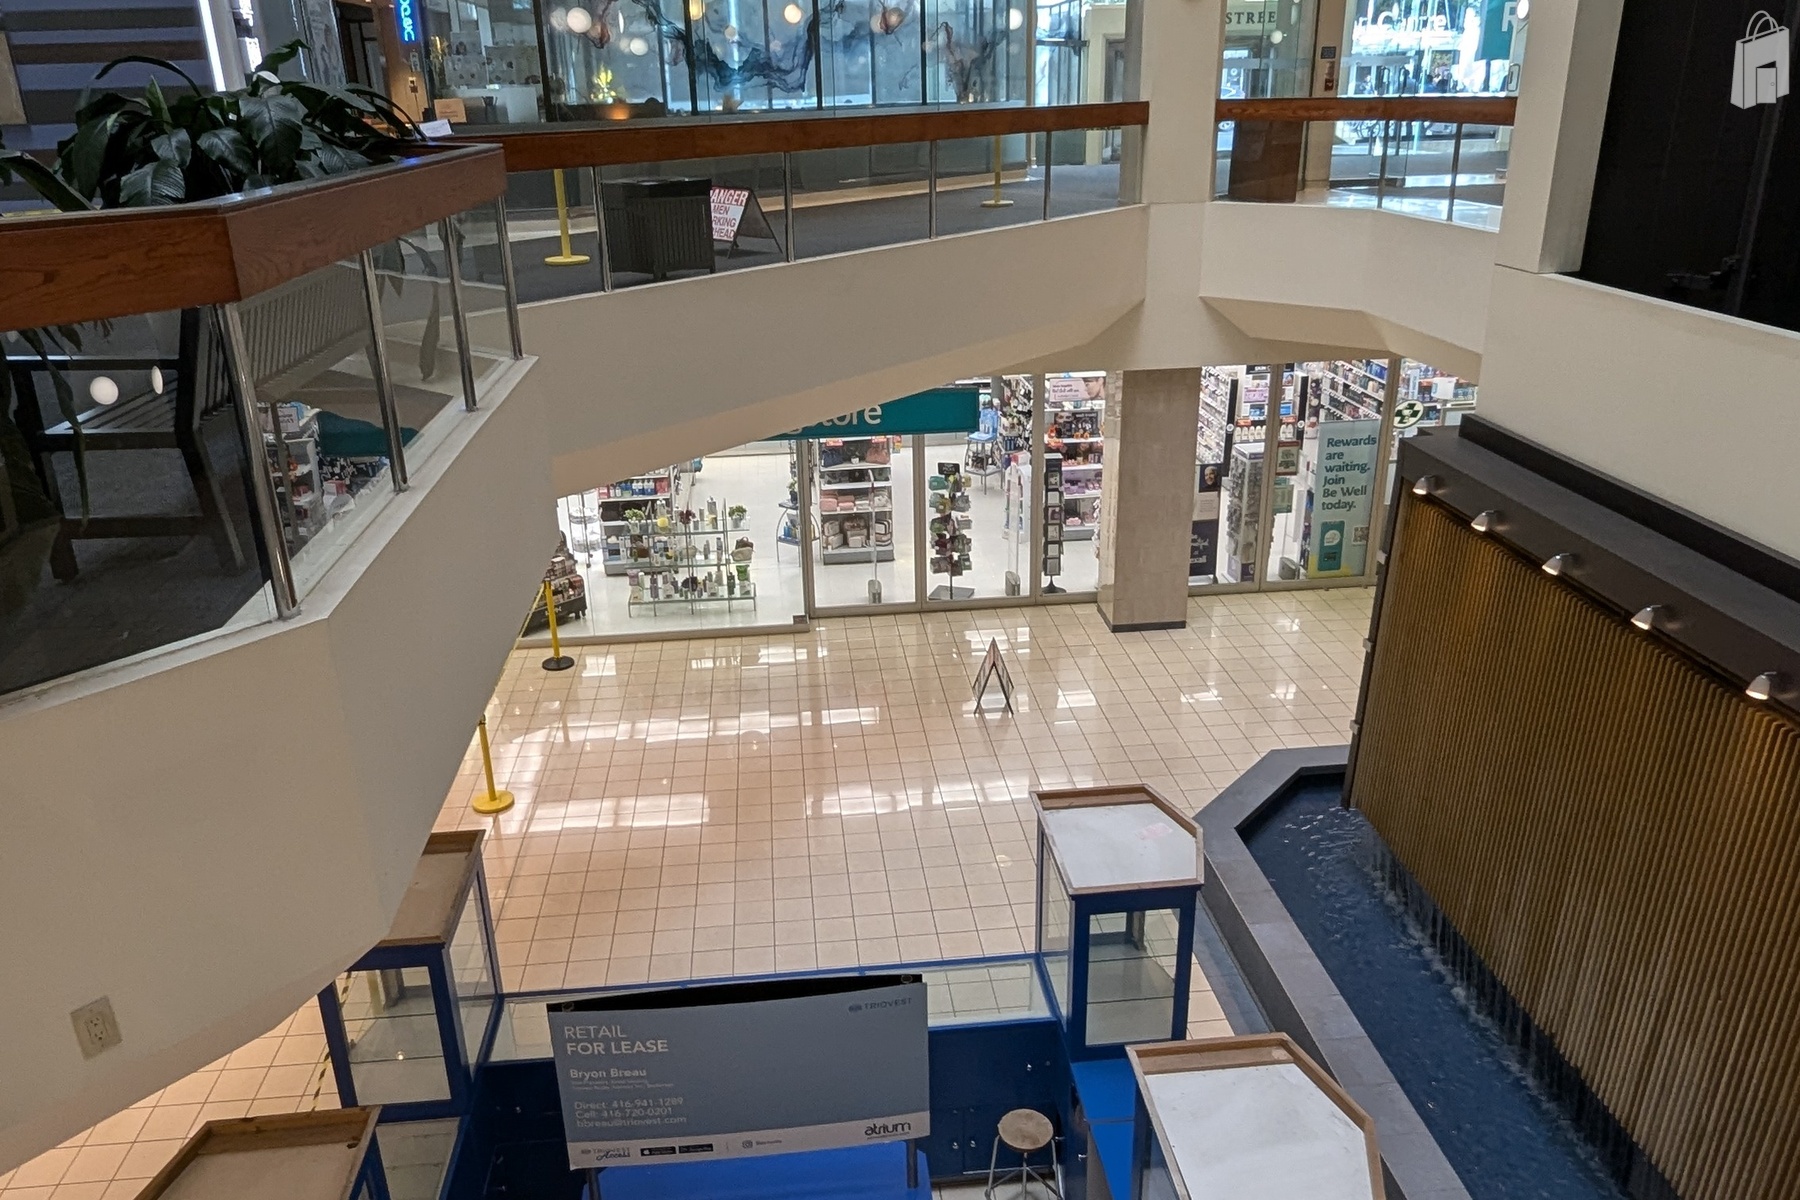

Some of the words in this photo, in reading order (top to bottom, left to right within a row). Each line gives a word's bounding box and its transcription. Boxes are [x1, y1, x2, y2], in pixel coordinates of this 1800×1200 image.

[1225, 11, 1277, 25] STREE
[710, 188, 749, 207] ANGER
[713, 204, 731, 216] MEN
[712, 216, 737, 228] RKING
[713, 227, 736, 239] HEAD
[1327, 435, 1377, 448] Rewards
[1325, 452, 1344, 460] are
[1324, 461, 1370, 474] waiting.
[1322, 474, 1345, 487] Join
[1322, 488, 1337, 498] Be
[1341, 485, 1368, 497] Well
[1321, 499, 1356, 512] today.
[864, 998, 912, 1010] TRIOVEST
[564, 1025, 627, 1039] RETAIL
[566, 1042, 605, 1055] FOR
[611, 1040, 669, 1054] LEASE
[570, 1069, 606, 1080] Bryon
[610, 1068, 647, 1077] Breau
[574, 1101, 609, 1110] Direct:
[575, 1110, 599, 1119] Cell:
[864, 1122, 911, 1136] atrium
